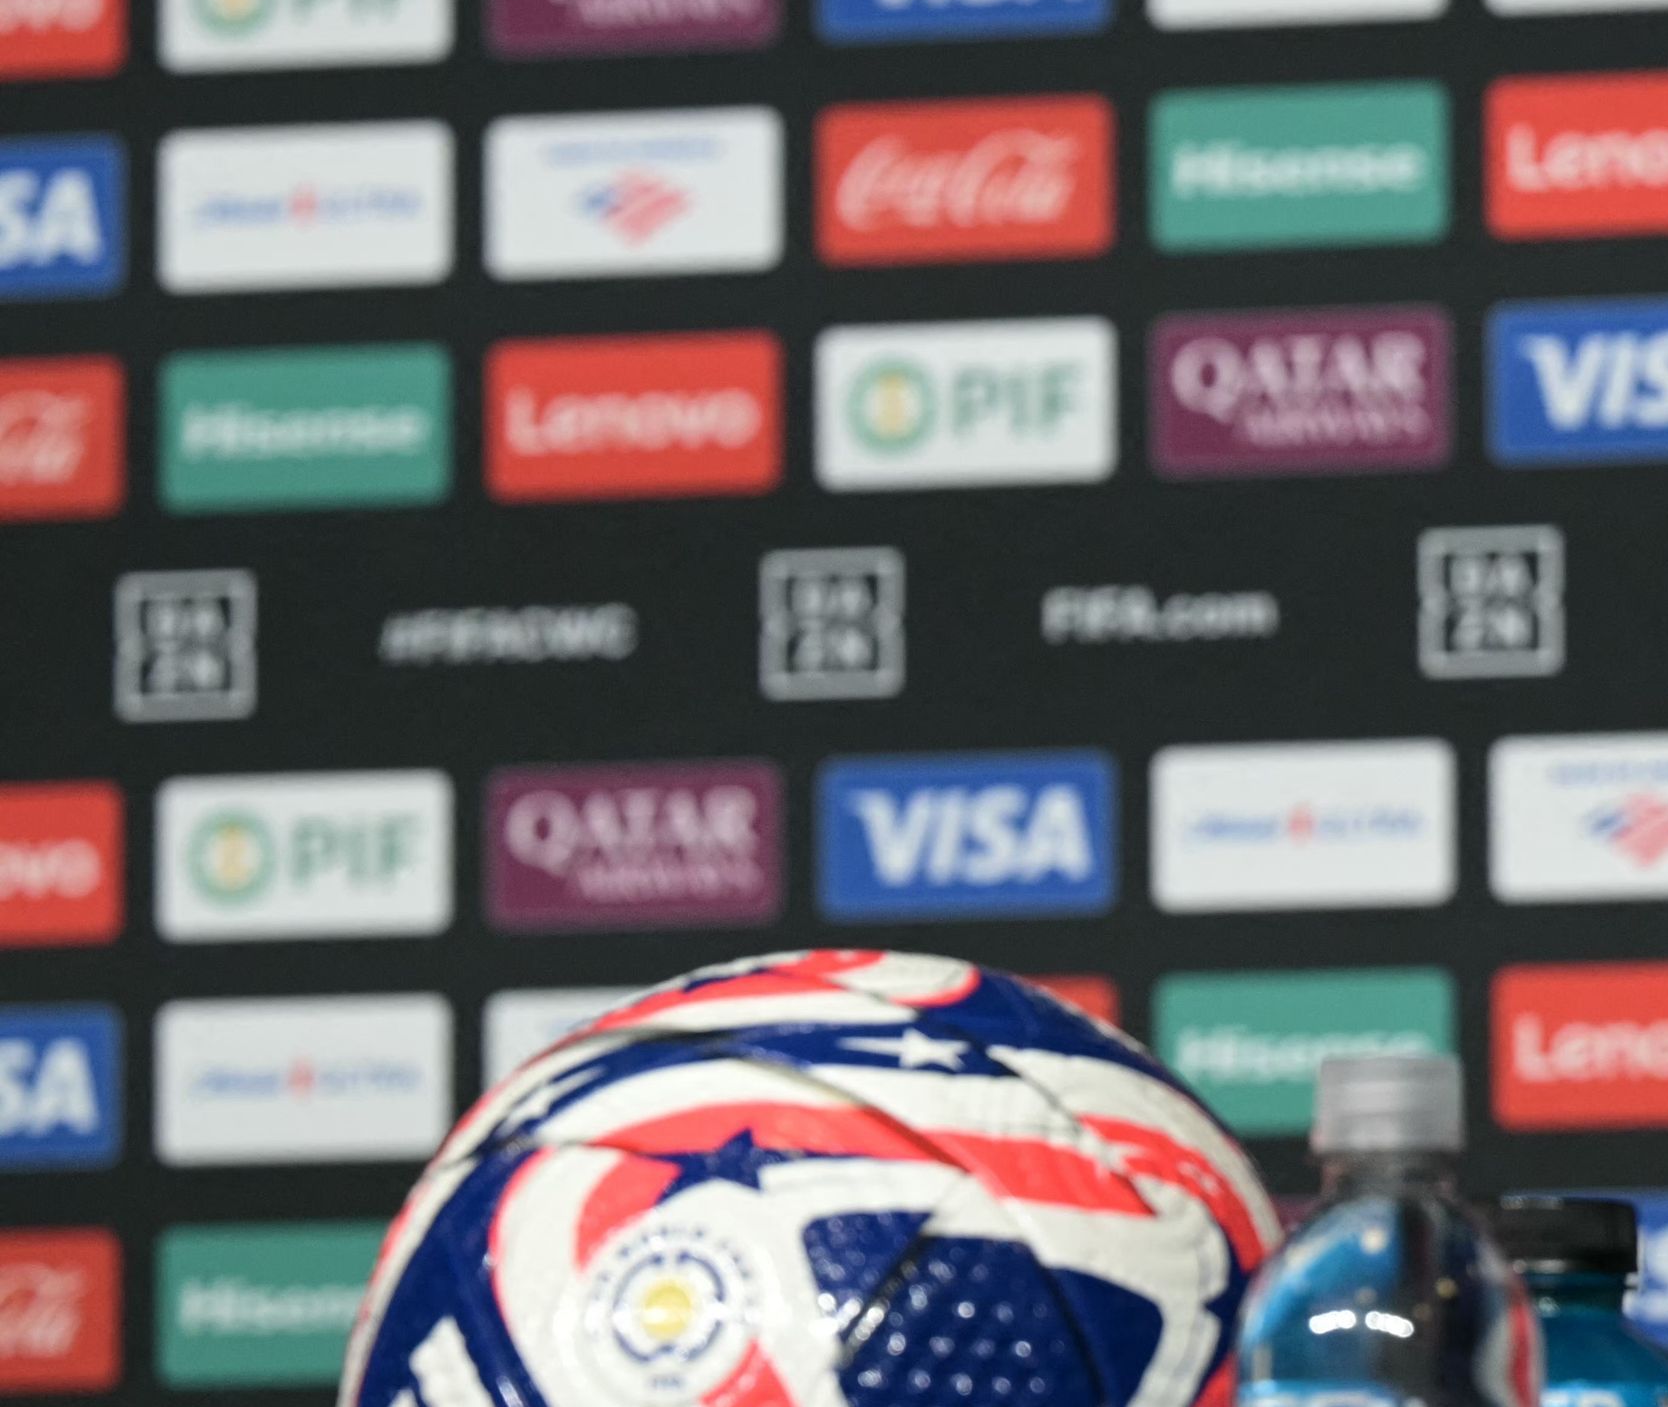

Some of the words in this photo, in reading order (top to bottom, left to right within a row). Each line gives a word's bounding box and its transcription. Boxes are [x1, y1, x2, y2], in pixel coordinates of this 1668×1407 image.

[1169, 144, 1425, 195] Hisense
[0, 172, 101, 266] SA
[945, 363, 1080, 437] PIF
[1175, 333, 1425, 421] QATAR
[504, 390, 762, 454] Lenovo
[281, 814, 417, 888] PIF
[509, 789, 755, 877] QATAR
[857, 787, 1092, 884] VISA
[0, 1041, 97, 1133] SA
[181, 1282, 362, 1335] Hisen
